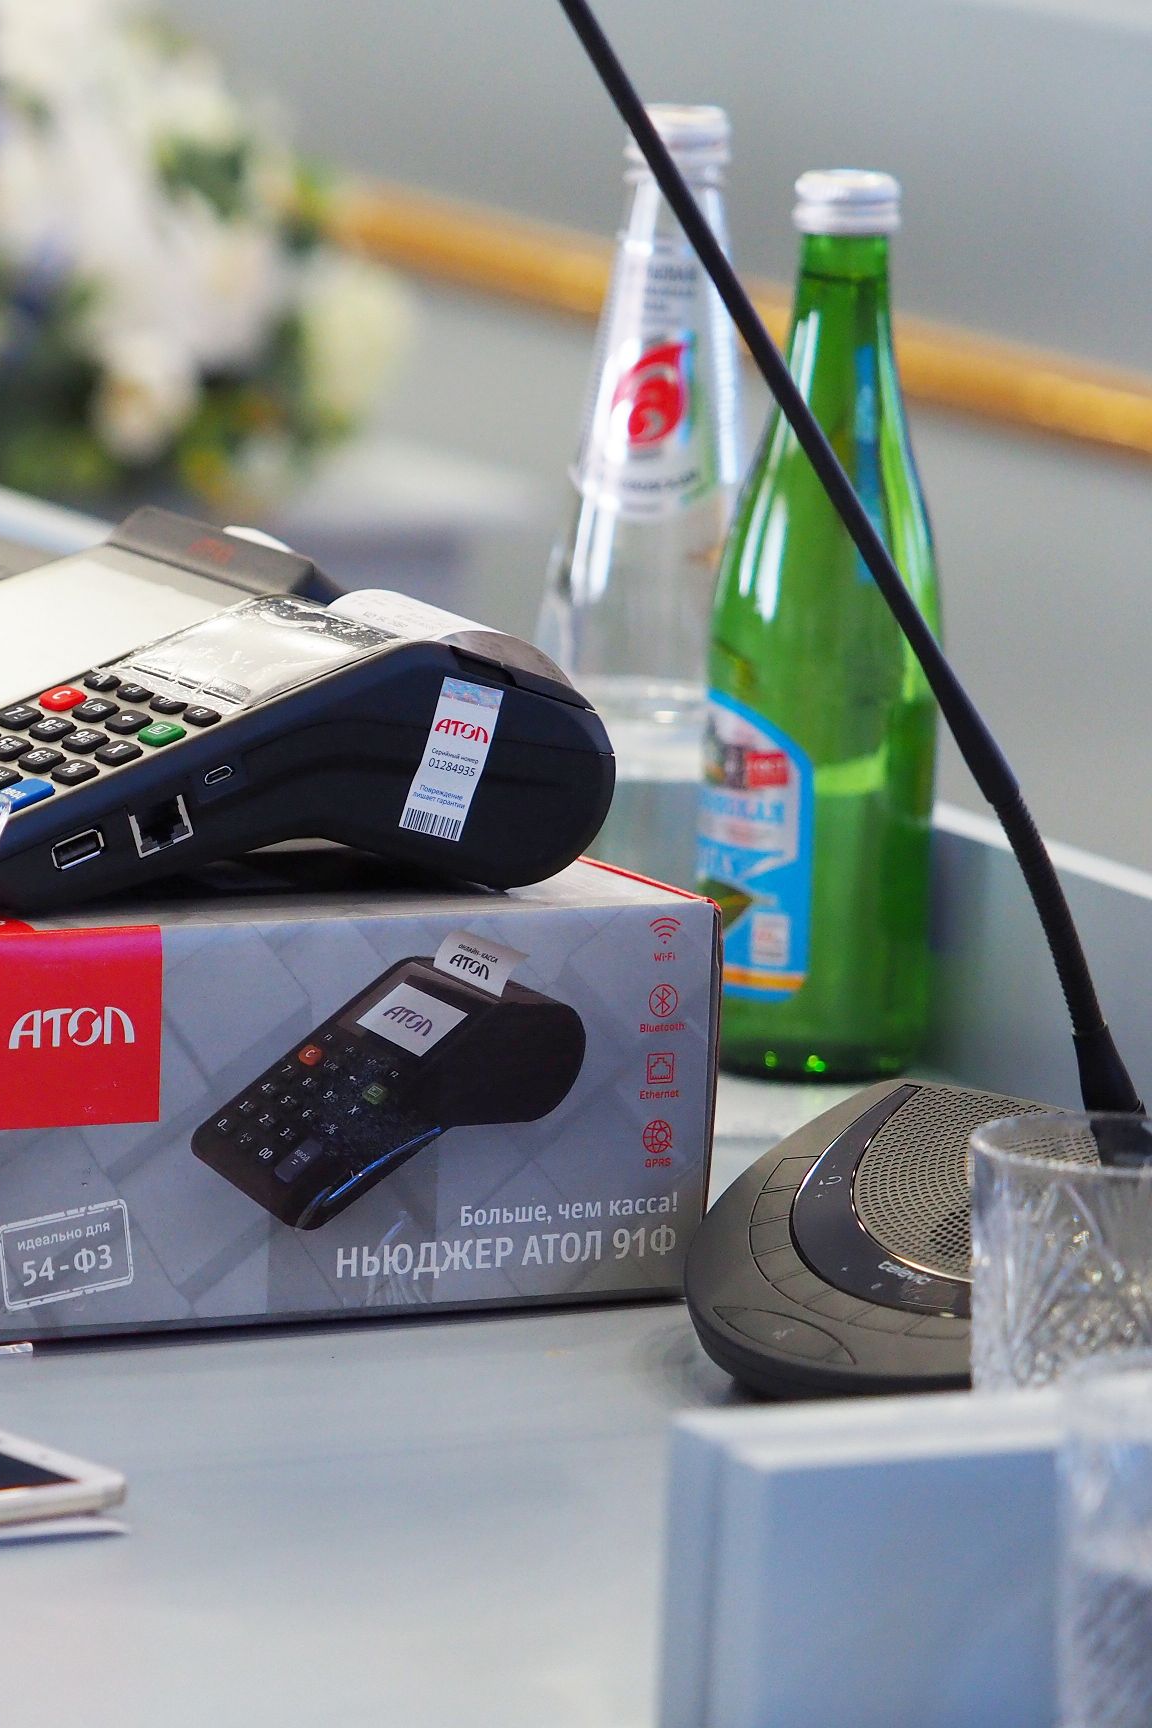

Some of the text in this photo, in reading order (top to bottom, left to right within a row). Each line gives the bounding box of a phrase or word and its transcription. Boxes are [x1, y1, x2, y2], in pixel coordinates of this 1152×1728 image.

[432, 748, 478, 765] Серийный номер
[428, 758, 475, 777] 01284935
[420, 784, 463, 800] Повреждение
[413, 792, 465, 808] лишает гарантии
[654, 952, 676, 962] Wi-Fi
[640, 1022, 685, 1033] Bluetooth
[302, 1077, 311, 1085] 8
[640, 1089, 679, 1099] Ethernet
[259, 1114, 269, 1122] 2
[302, 1110, 312, 1118] 6
[280, 1128, 290, 1136] 3
[645, 1158, 672, 1168] GPRS
[461, 1191, 678, 1227] Больше, чем касса!
[17, 1222, 111, 1251] идеально для
[336, 1224, 676, 1280] НЬЮДЖЕР АТОЛ 91Ф
